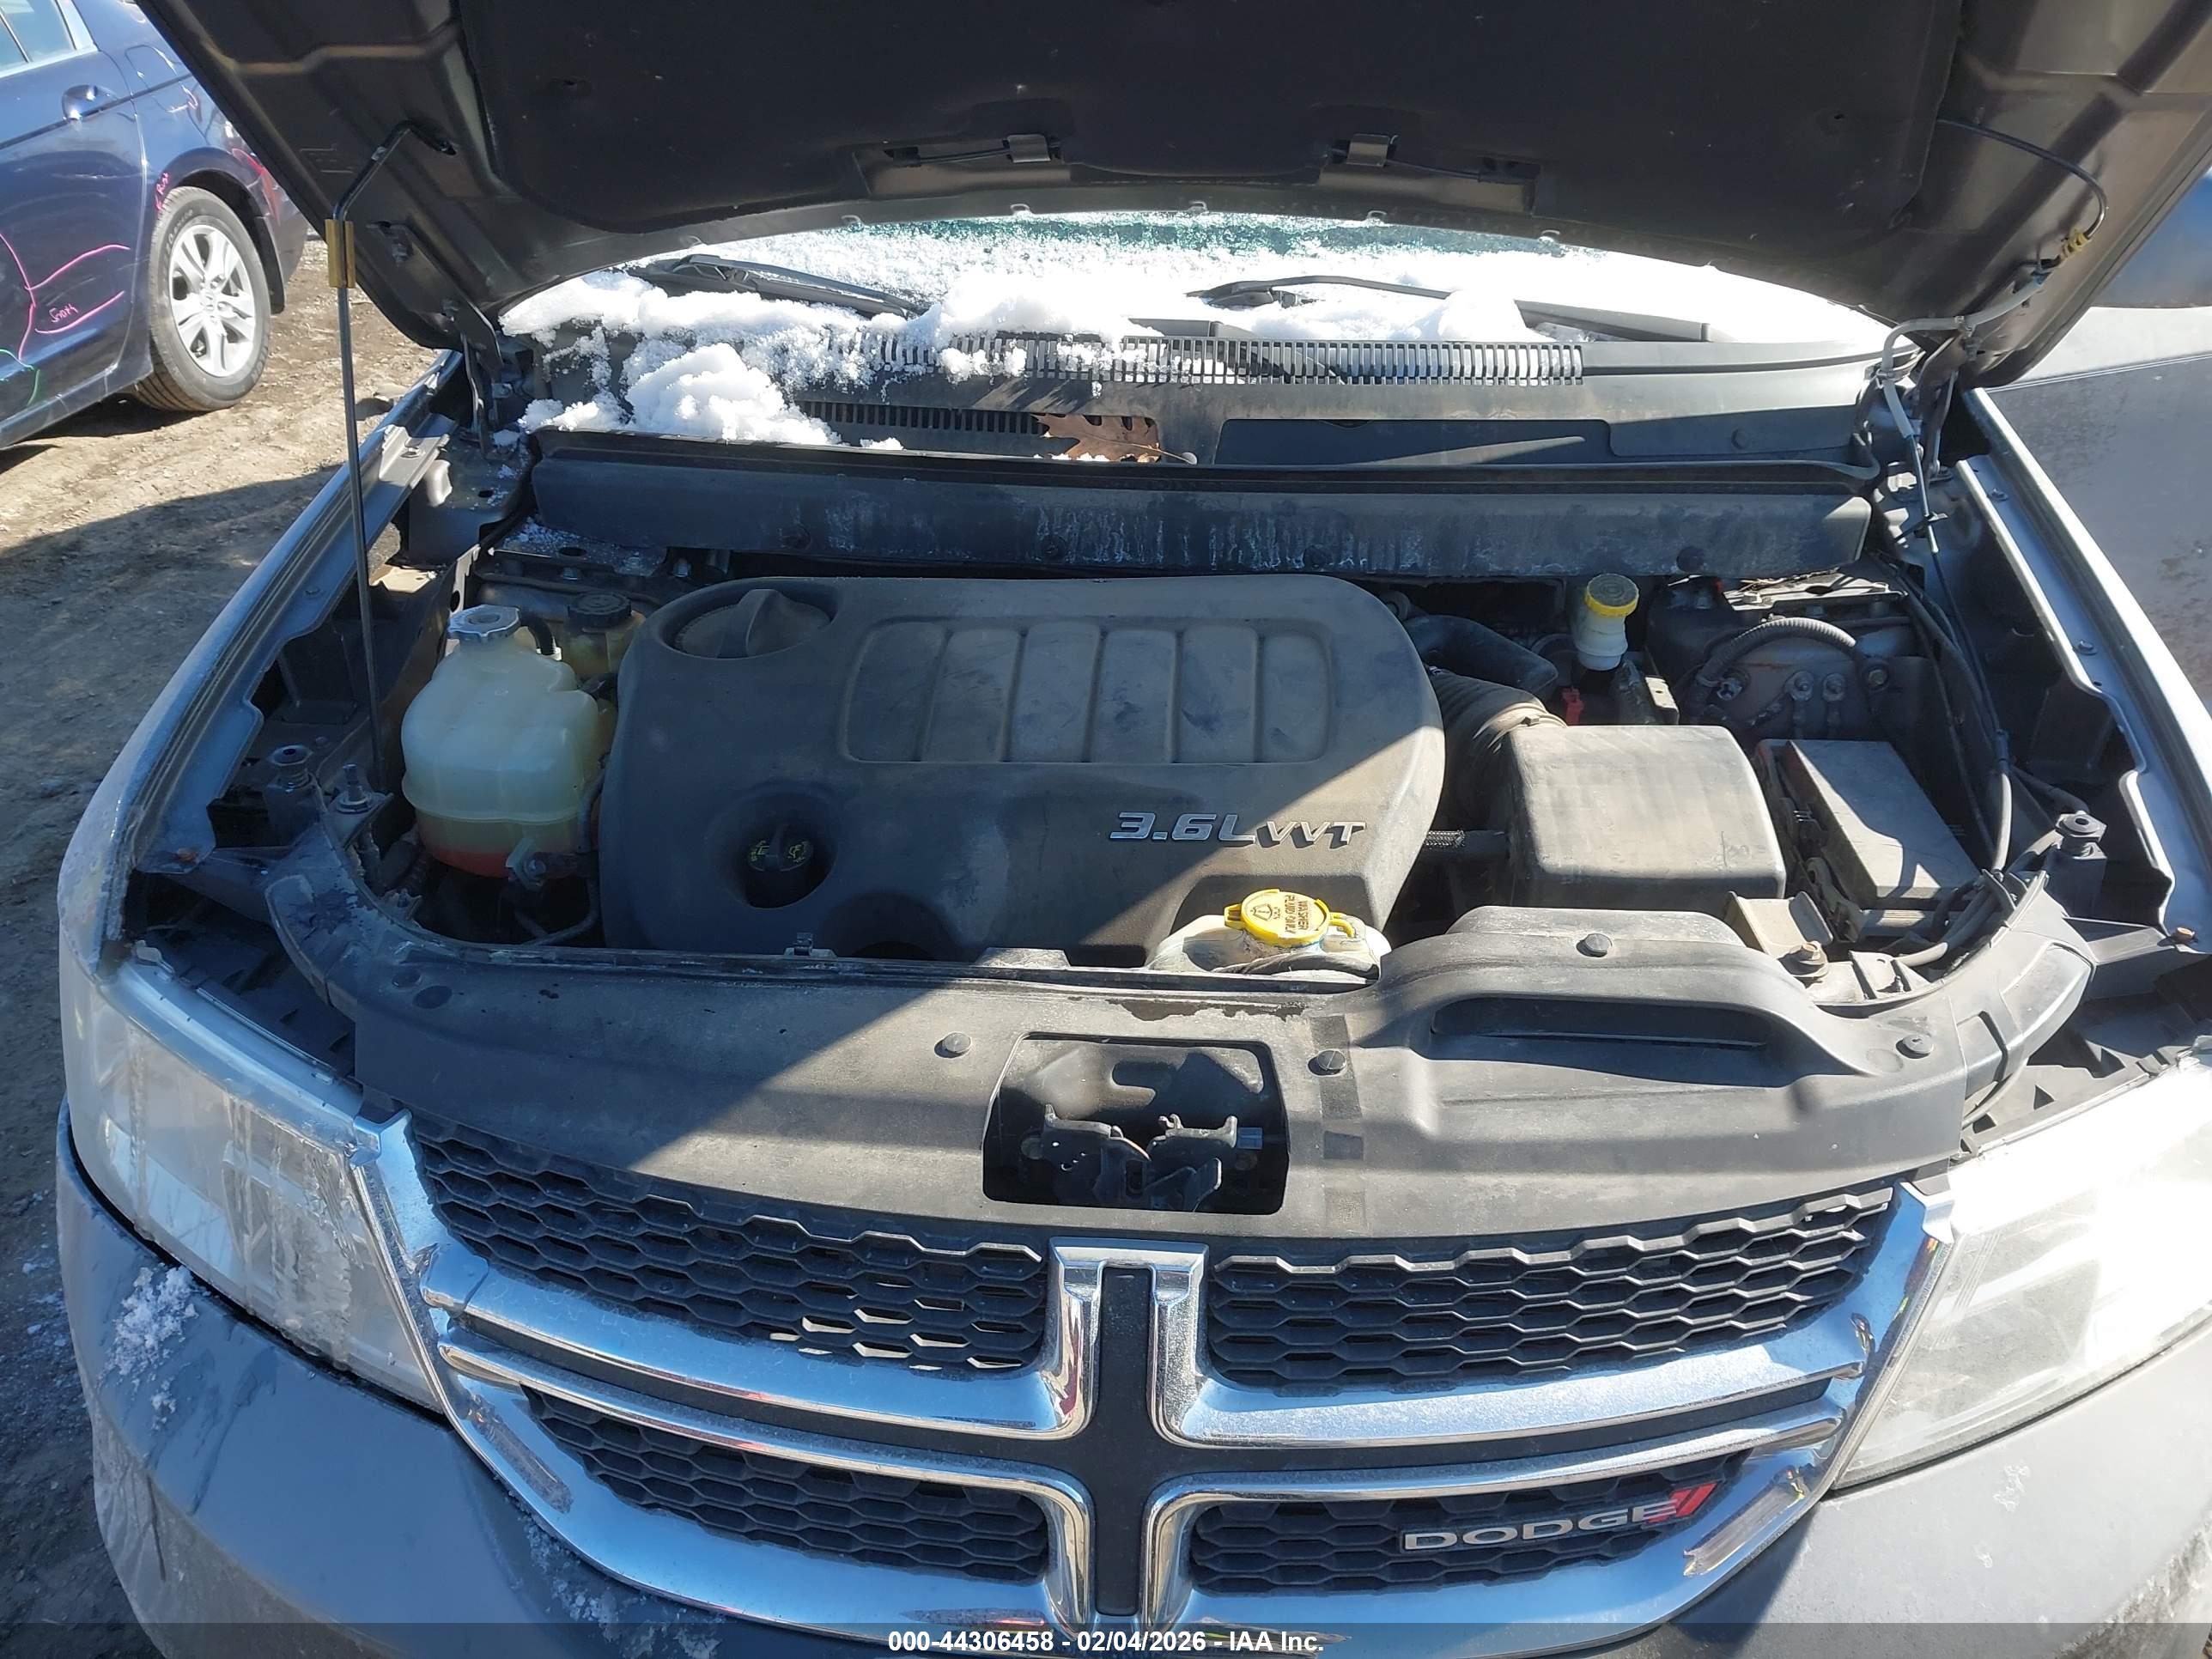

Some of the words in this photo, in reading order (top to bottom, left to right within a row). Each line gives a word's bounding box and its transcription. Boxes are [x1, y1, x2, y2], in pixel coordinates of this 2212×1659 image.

[1109, 811, 1256, 844] 3.6L
[1266, 821, 1366, 844] VVT
[1284, 894, 1296, 915] FLUID
[1297, 900, 1310, 931] WASHER
[1404, 1499, 1678, 1550] DODGE
